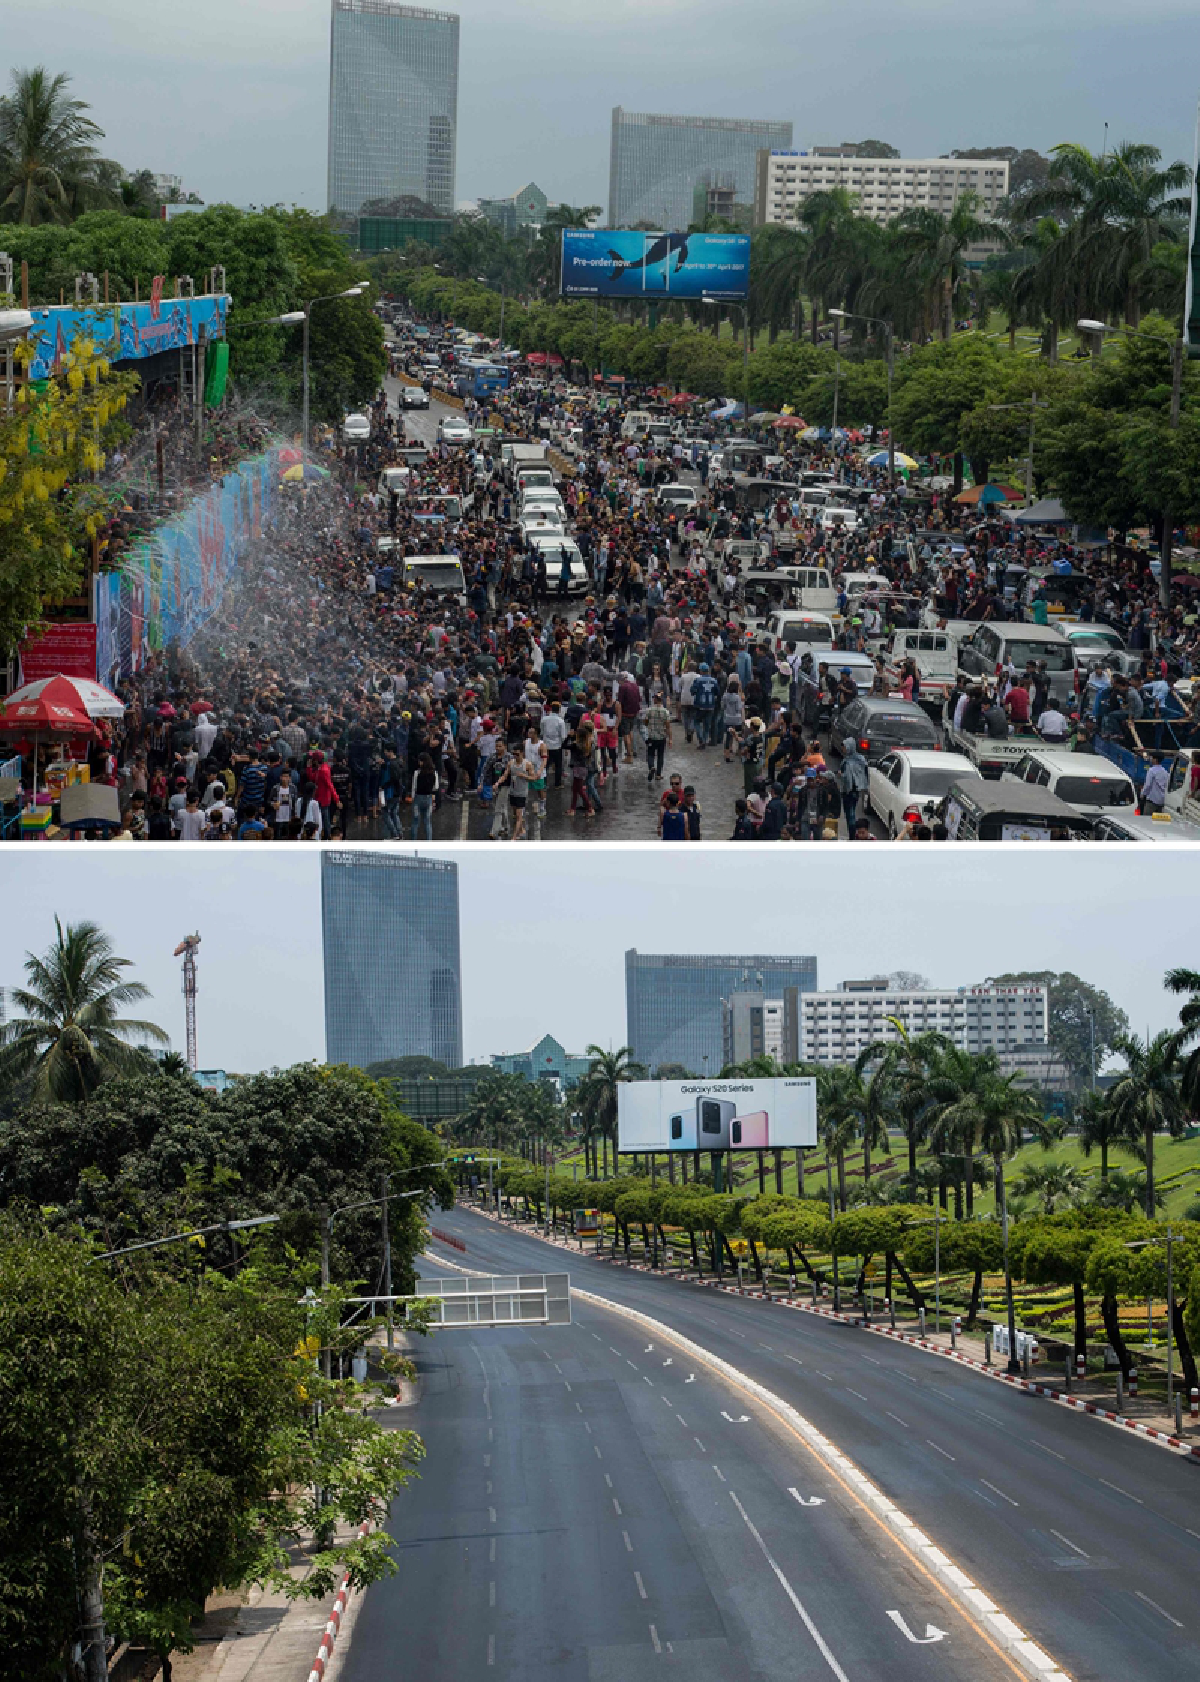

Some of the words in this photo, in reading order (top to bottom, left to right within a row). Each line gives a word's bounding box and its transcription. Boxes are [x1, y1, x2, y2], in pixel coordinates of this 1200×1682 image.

[573, 257, 612, 267] Pre-order
[681, 1086, 711, 1094] Galaxy
[713, 1085, 727, 1093] S20
[728, 1083, 754, 1092] Series
